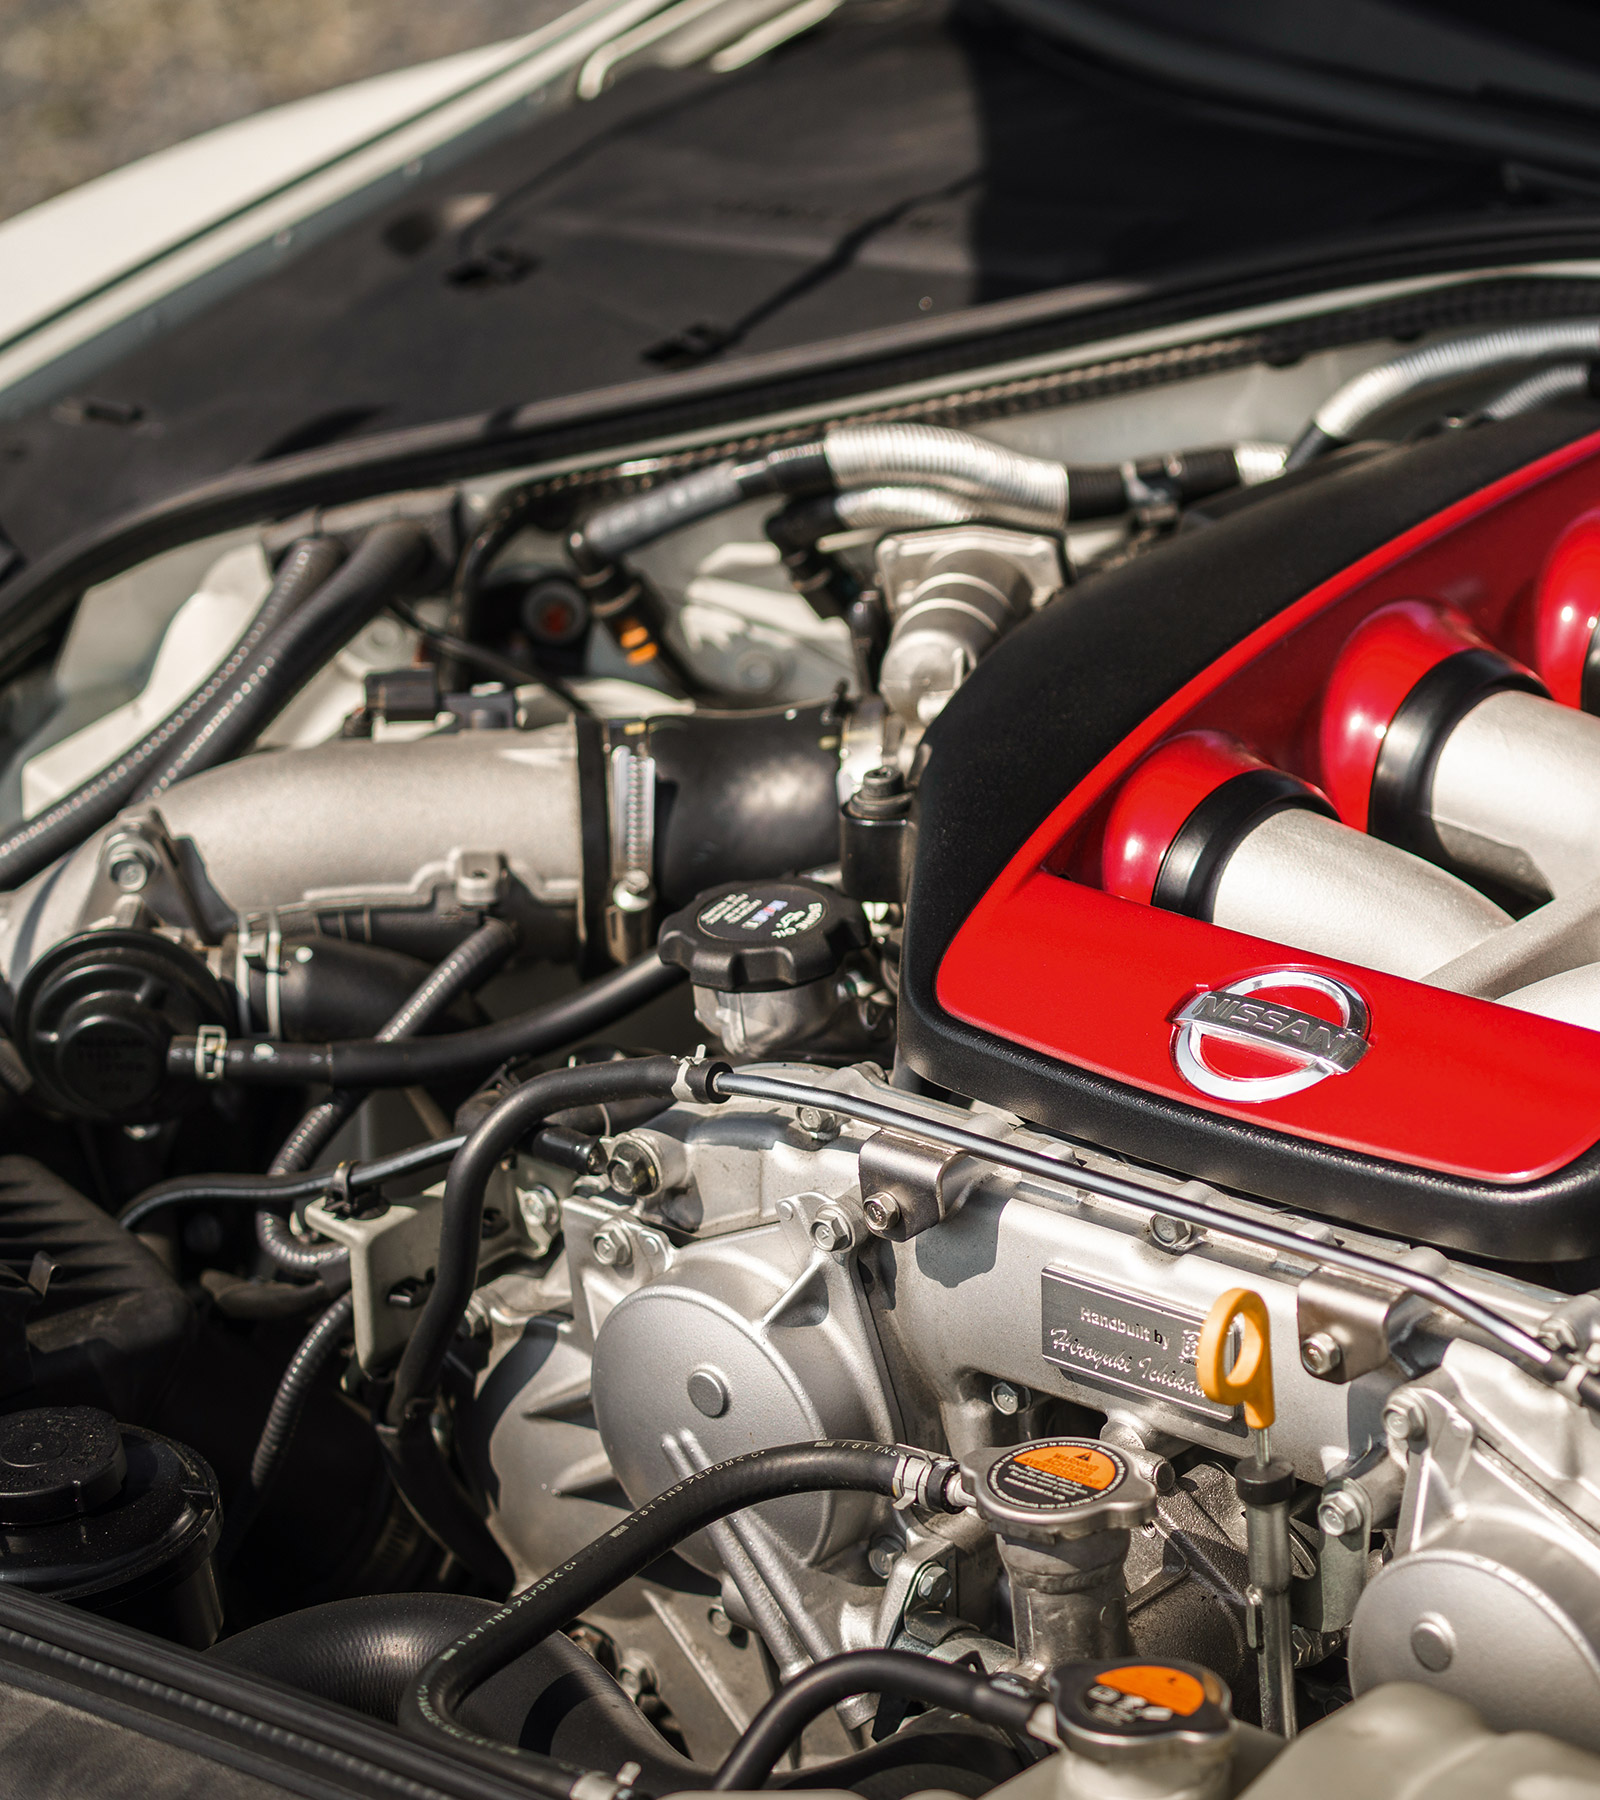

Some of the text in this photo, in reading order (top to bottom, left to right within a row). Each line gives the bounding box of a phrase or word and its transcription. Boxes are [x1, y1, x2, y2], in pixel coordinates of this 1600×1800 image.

[1191, 994, 1344, 1052] NISSAN
[1050, 1328, 1132, 1372] Hiroyuki
[1080, 1306, 1151, 1342] Handbuilt
[1153, 1329, 1171, 1350] by
[1053, 1453, 1099, 1472] WARNING
